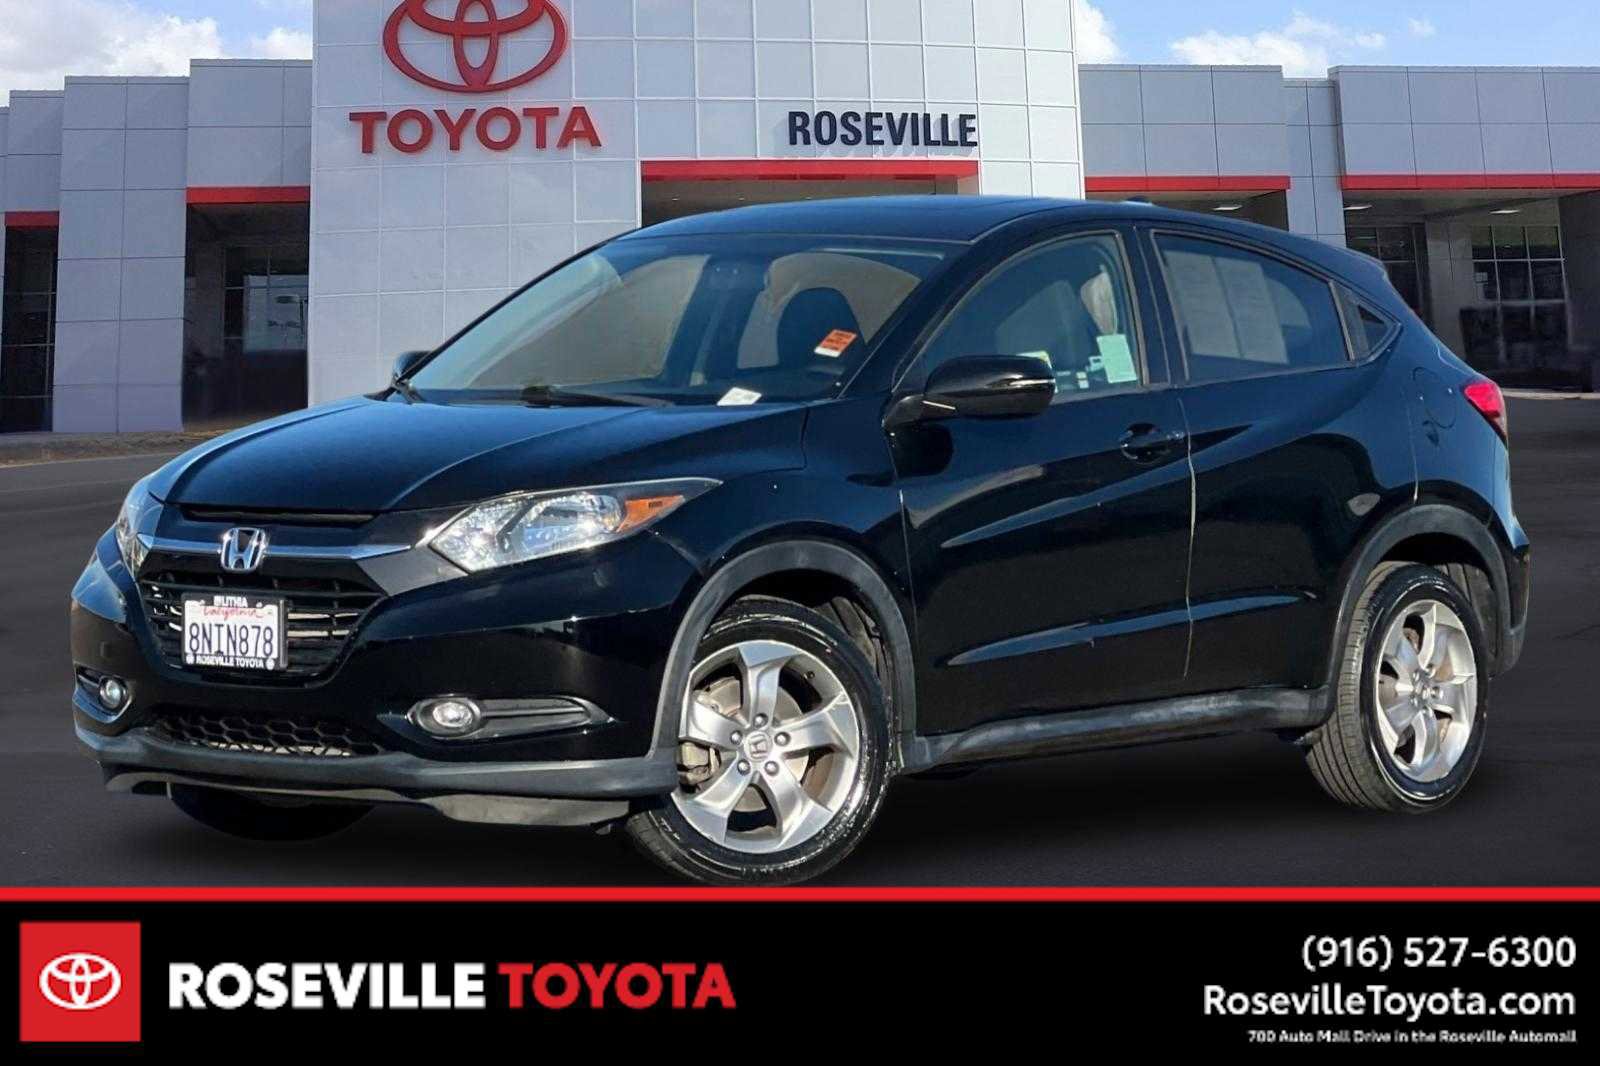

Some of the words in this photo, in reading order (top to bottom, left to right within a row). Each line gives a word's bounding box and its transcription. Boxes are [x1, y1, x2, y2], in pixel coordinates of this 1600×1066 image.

[349, 106, 602, 154] TOYOTA
[789, 111, 977, 147] ROSEVILLE
[189, 622, 273, 658] 8NIN878
[196, 655, 234, 667] ROSEVILLE
[236, 658, 264, 669] TOYOTA
